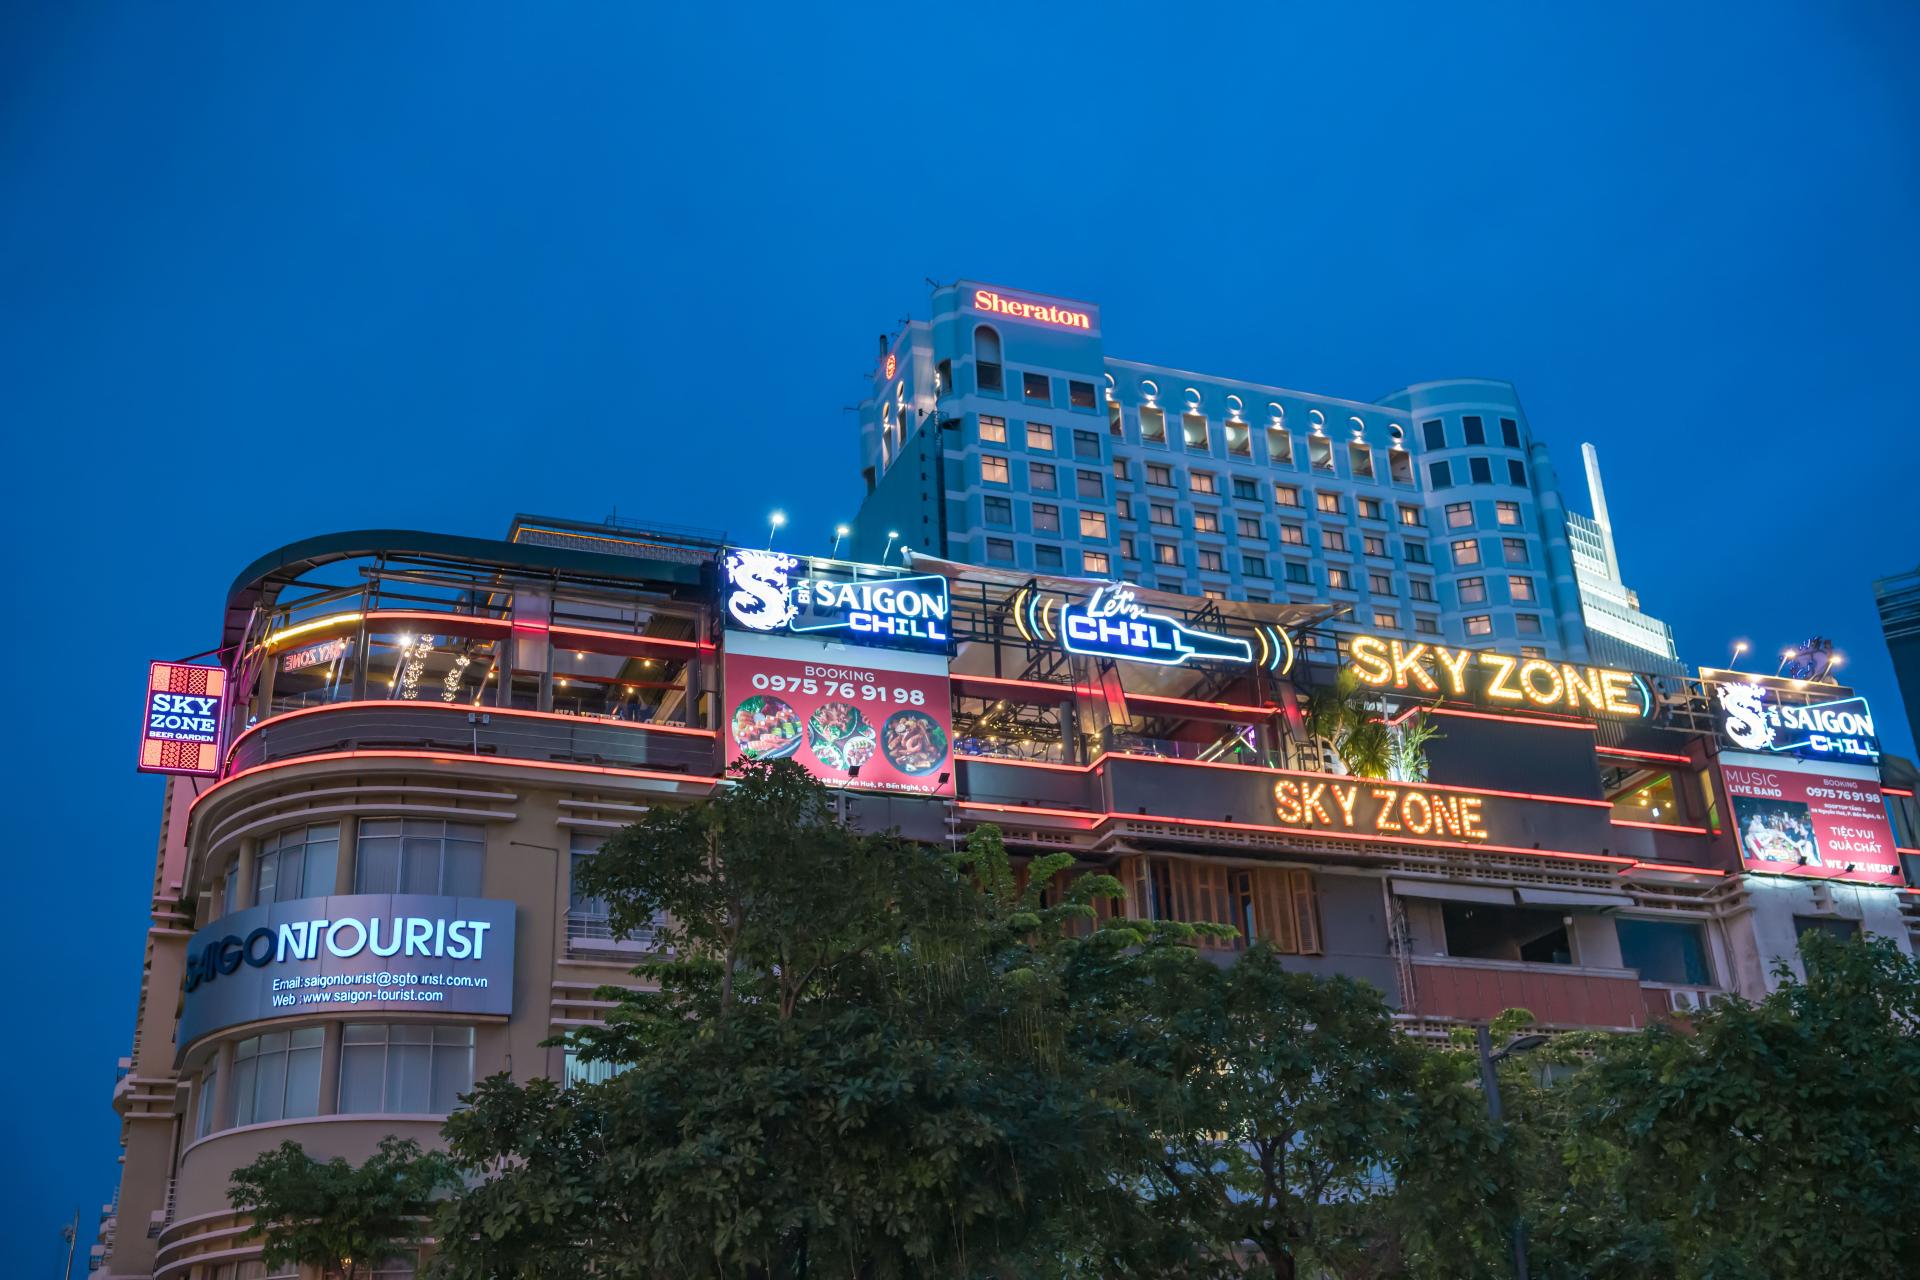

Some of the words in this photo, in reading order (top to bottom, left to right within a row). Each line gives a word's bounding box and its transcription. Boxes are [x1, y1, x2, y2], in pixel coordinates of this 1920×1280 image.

[975, 290, 1089, 328] Sheraton
[797, 579, 810, 604] BIA
[815, 580, 944, 620] SAIGON
[849, 611, 946, 640] CHILL
[1068, 614, 1195, 654] CHILL
[805, 666, 875, 682] BOOKING
[1349, 635, 1472, 694] SKY
[1480, 653, 1641, 716] ZONE
[752, 673, 818, 694] 0975
[824, 681, 855, 698] 76
[861, 686, 887, 703] 91
[893, 688, 925, 705] 98
[152, 693, 217, 715] SKY
[150, 714, 215, 732] ZONE
[1782, 705, 1875, 736] SAIGON
[149, 731, 173, 739] BEER
[175, 732, 214, 742] GARDEN
[1810, 735, 1879, 756] CHILL
[1726, 770, 1780, 788] MUSIC
[1823, 778, 1858, 789] BOOKING
[1729, 785, 1752, 794] LIVE
[1754, 787, 1782, 797] BAND
[1806, 787, 1836, 799] 0975
[1836, 790, 1851, 800] 76
[1852, 791, 1865, 801] 91
[1865, 793, 1881, 804] 98
[1274, 780, 1358, 826] SKY
[1372, 788, 1488, 839] ZONE
[1830, 826, 1855, 839] TIỆC
[1856, 829, 1874, 839] VUI
[1853, 839, 1882, 854] CHẤT
[1825, 859, 1843, 869] WE
